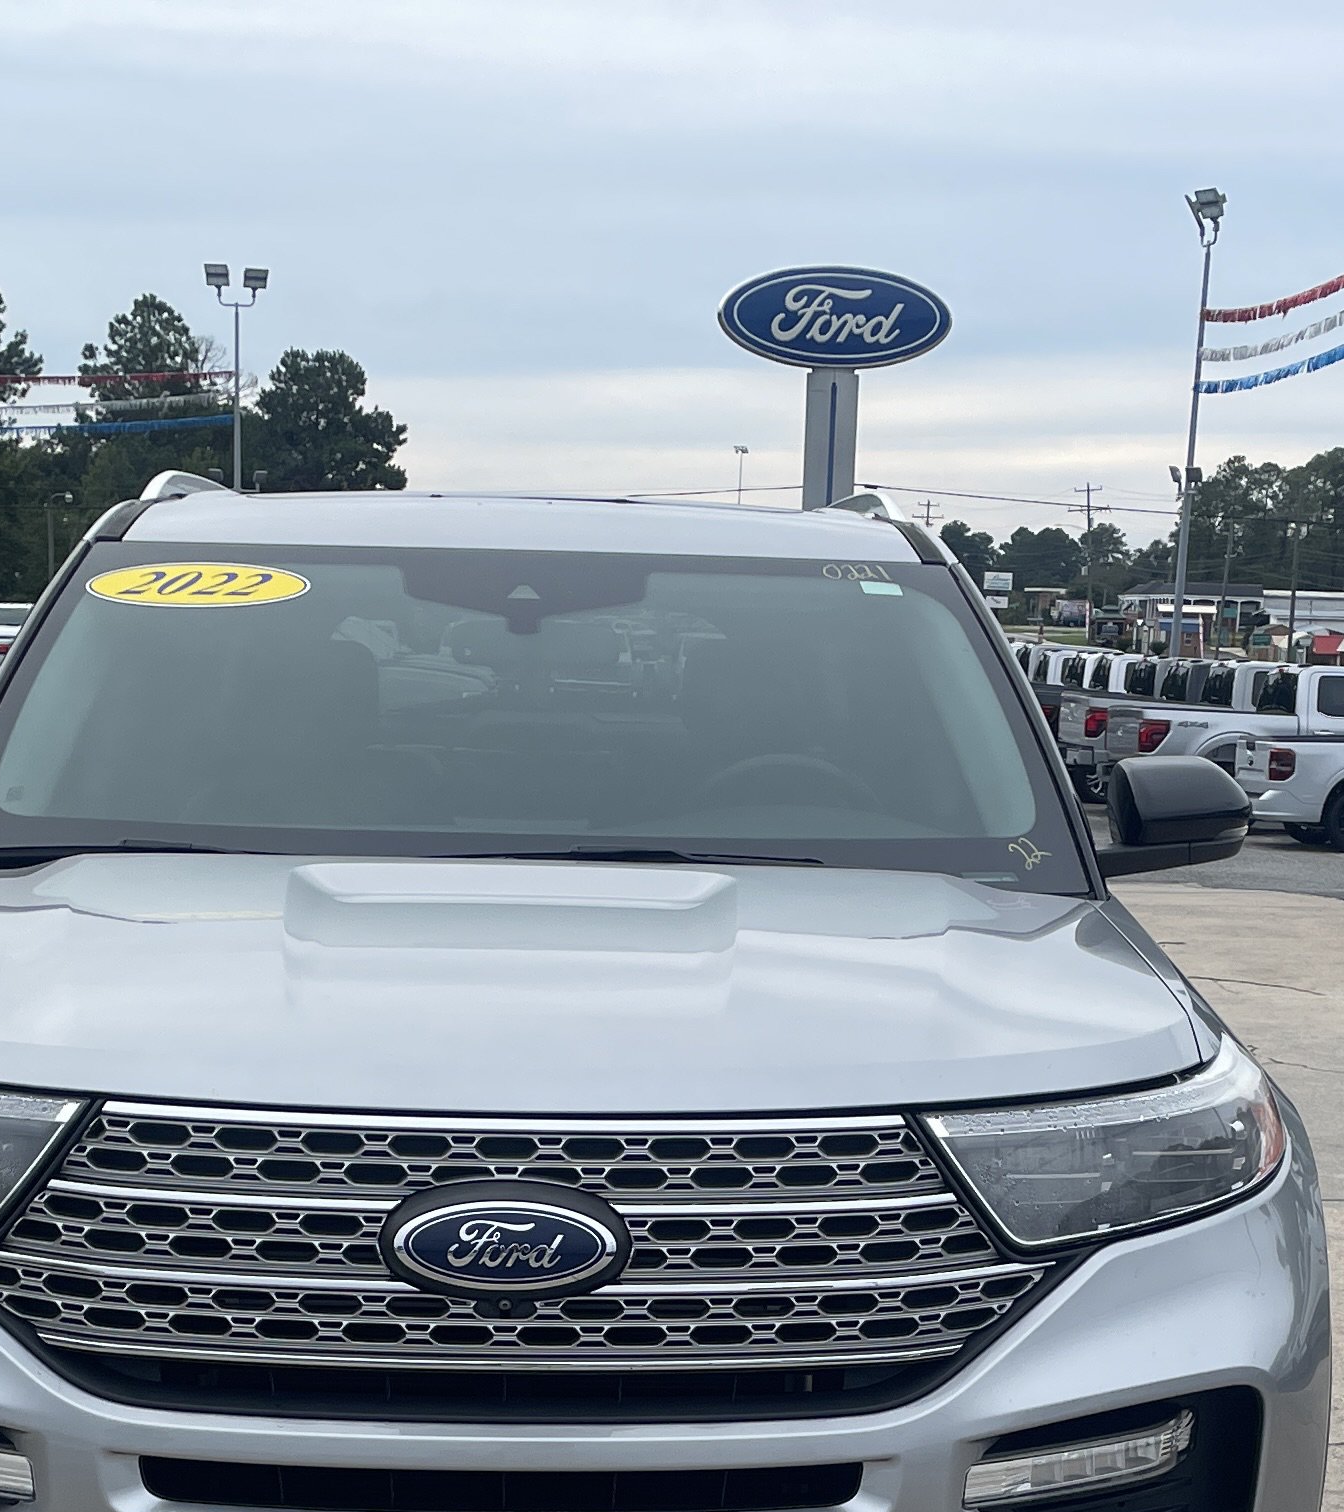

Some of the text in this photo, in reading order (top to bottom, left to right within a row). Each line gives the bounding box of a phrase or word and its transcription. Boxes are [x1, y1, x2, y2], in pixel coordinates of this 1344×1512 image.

[770, 283, 905, 345] Ford
[115, 571, 273, 596] 2022
[447, 1219, 564, 1270] Ford
